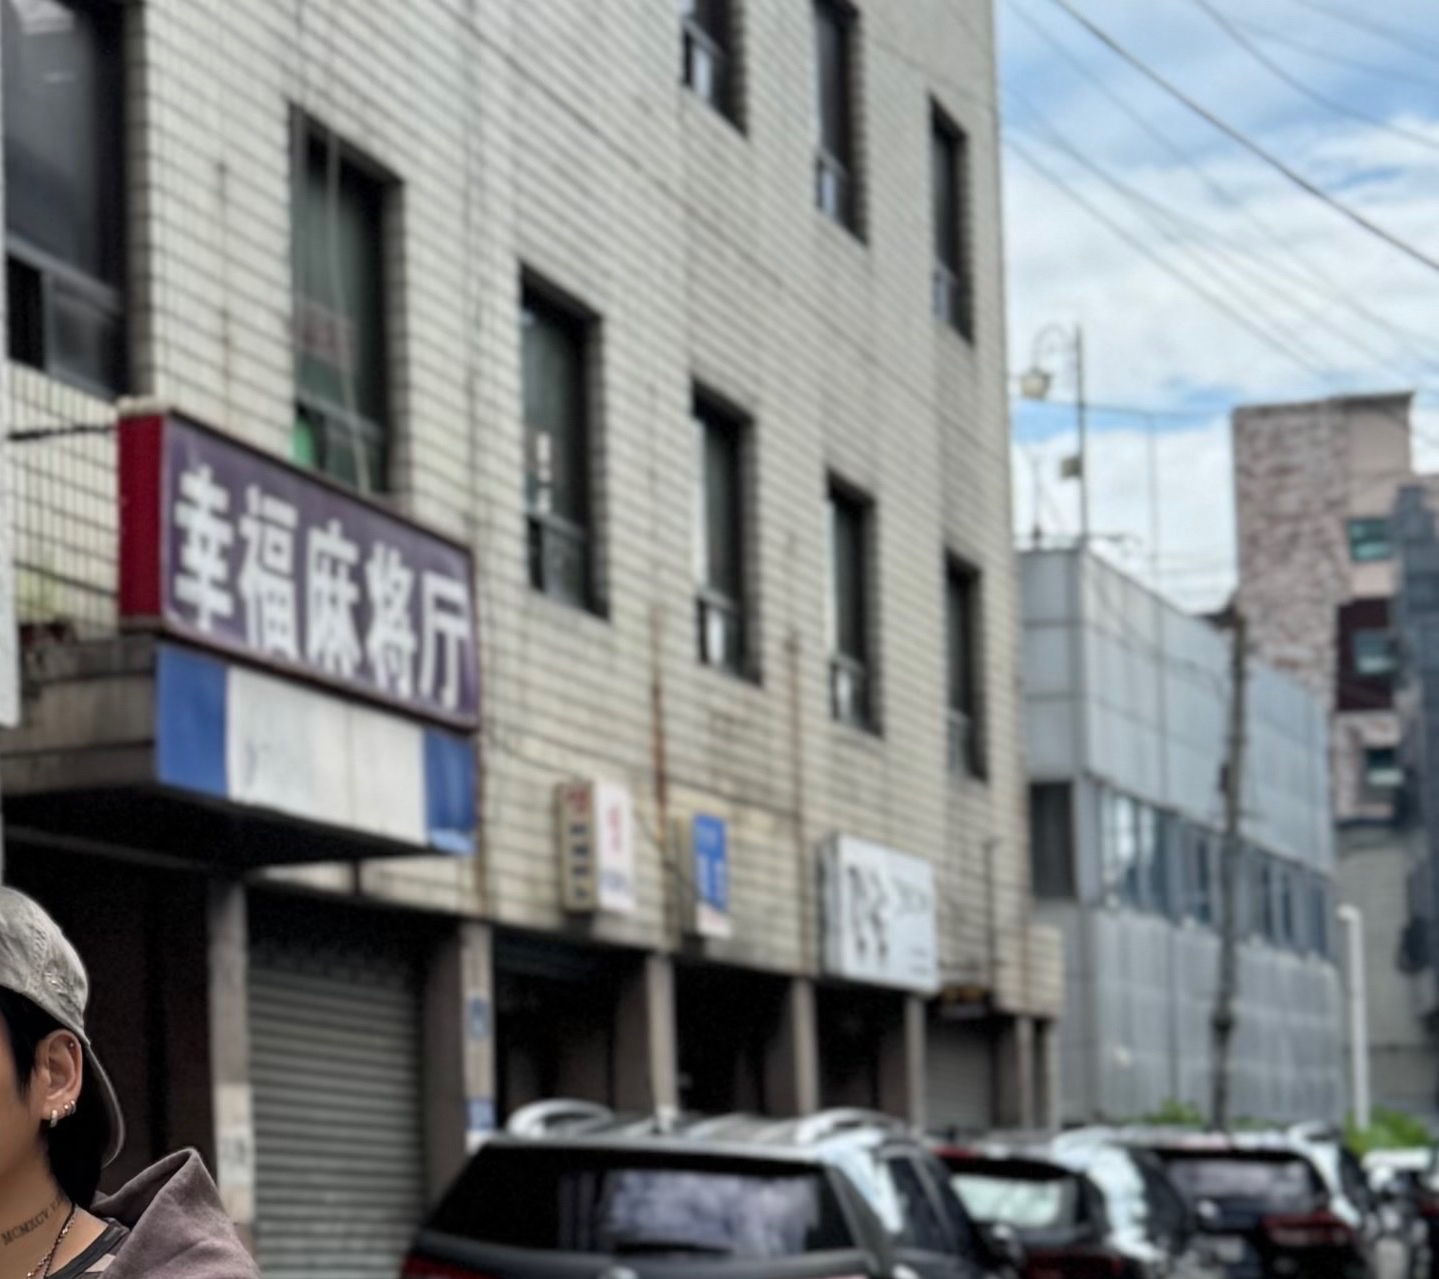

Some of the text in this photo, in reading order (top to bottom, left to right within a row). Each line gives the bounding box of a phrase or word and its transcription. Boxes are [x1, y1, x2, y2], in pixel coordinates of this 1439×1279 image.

[174, 464, 469, 711] 幸福麻将厅
